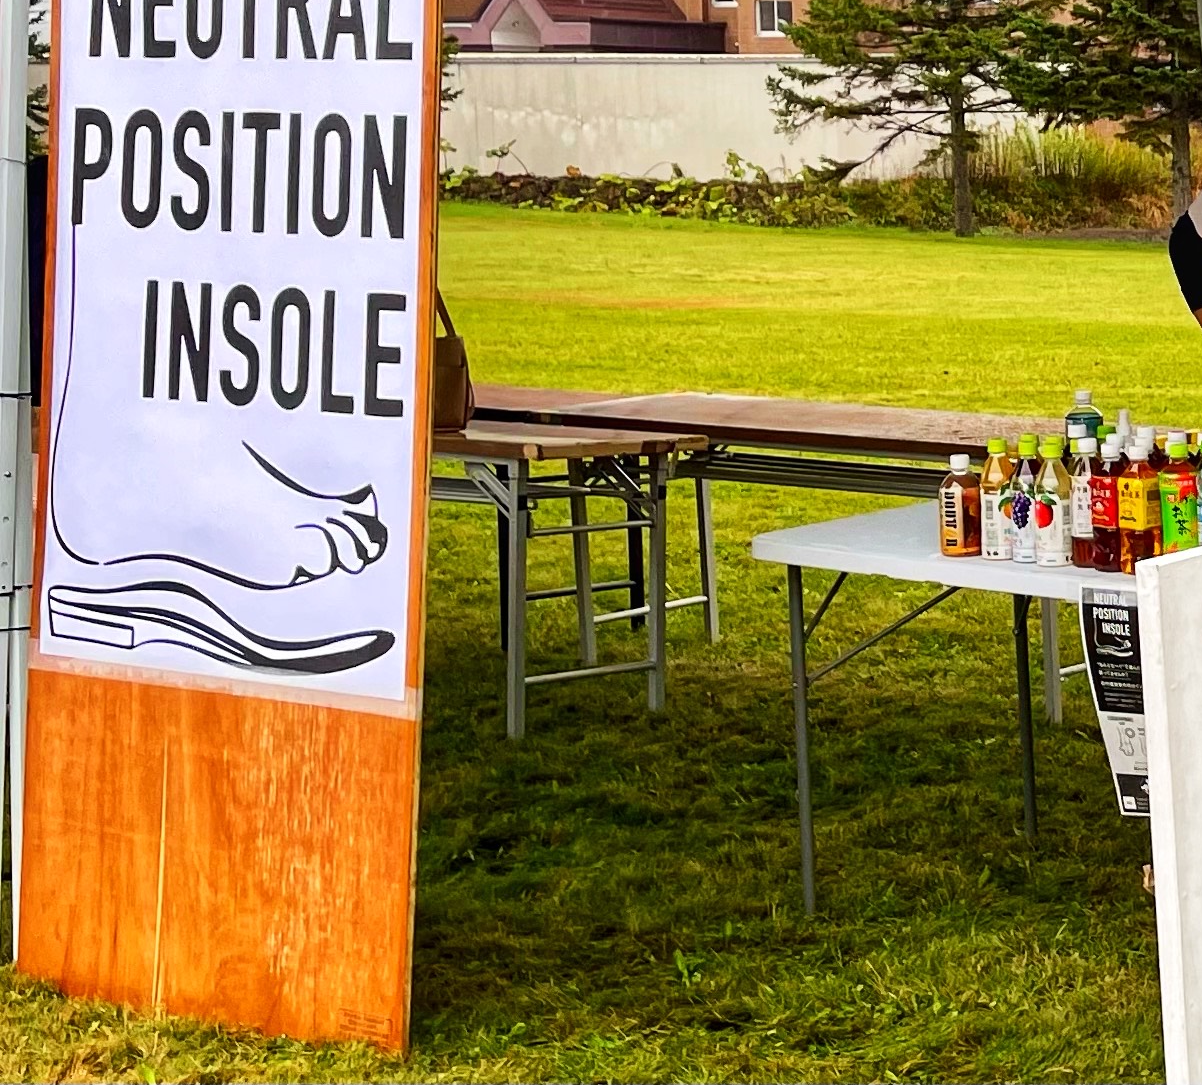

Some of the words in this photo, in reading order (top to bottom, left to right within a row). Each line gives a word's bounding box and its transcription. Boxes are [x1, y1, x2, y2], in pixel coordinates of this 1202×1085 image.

[70, 106, 408, 240] POSITION
[142, 279, 407, 417] INSOLE
[1093, 592, 1128, 607] NEUTRAL
[1092, 606, 1130, 622] POSITION
[1101, 622, 1131, 637] INSOLE
